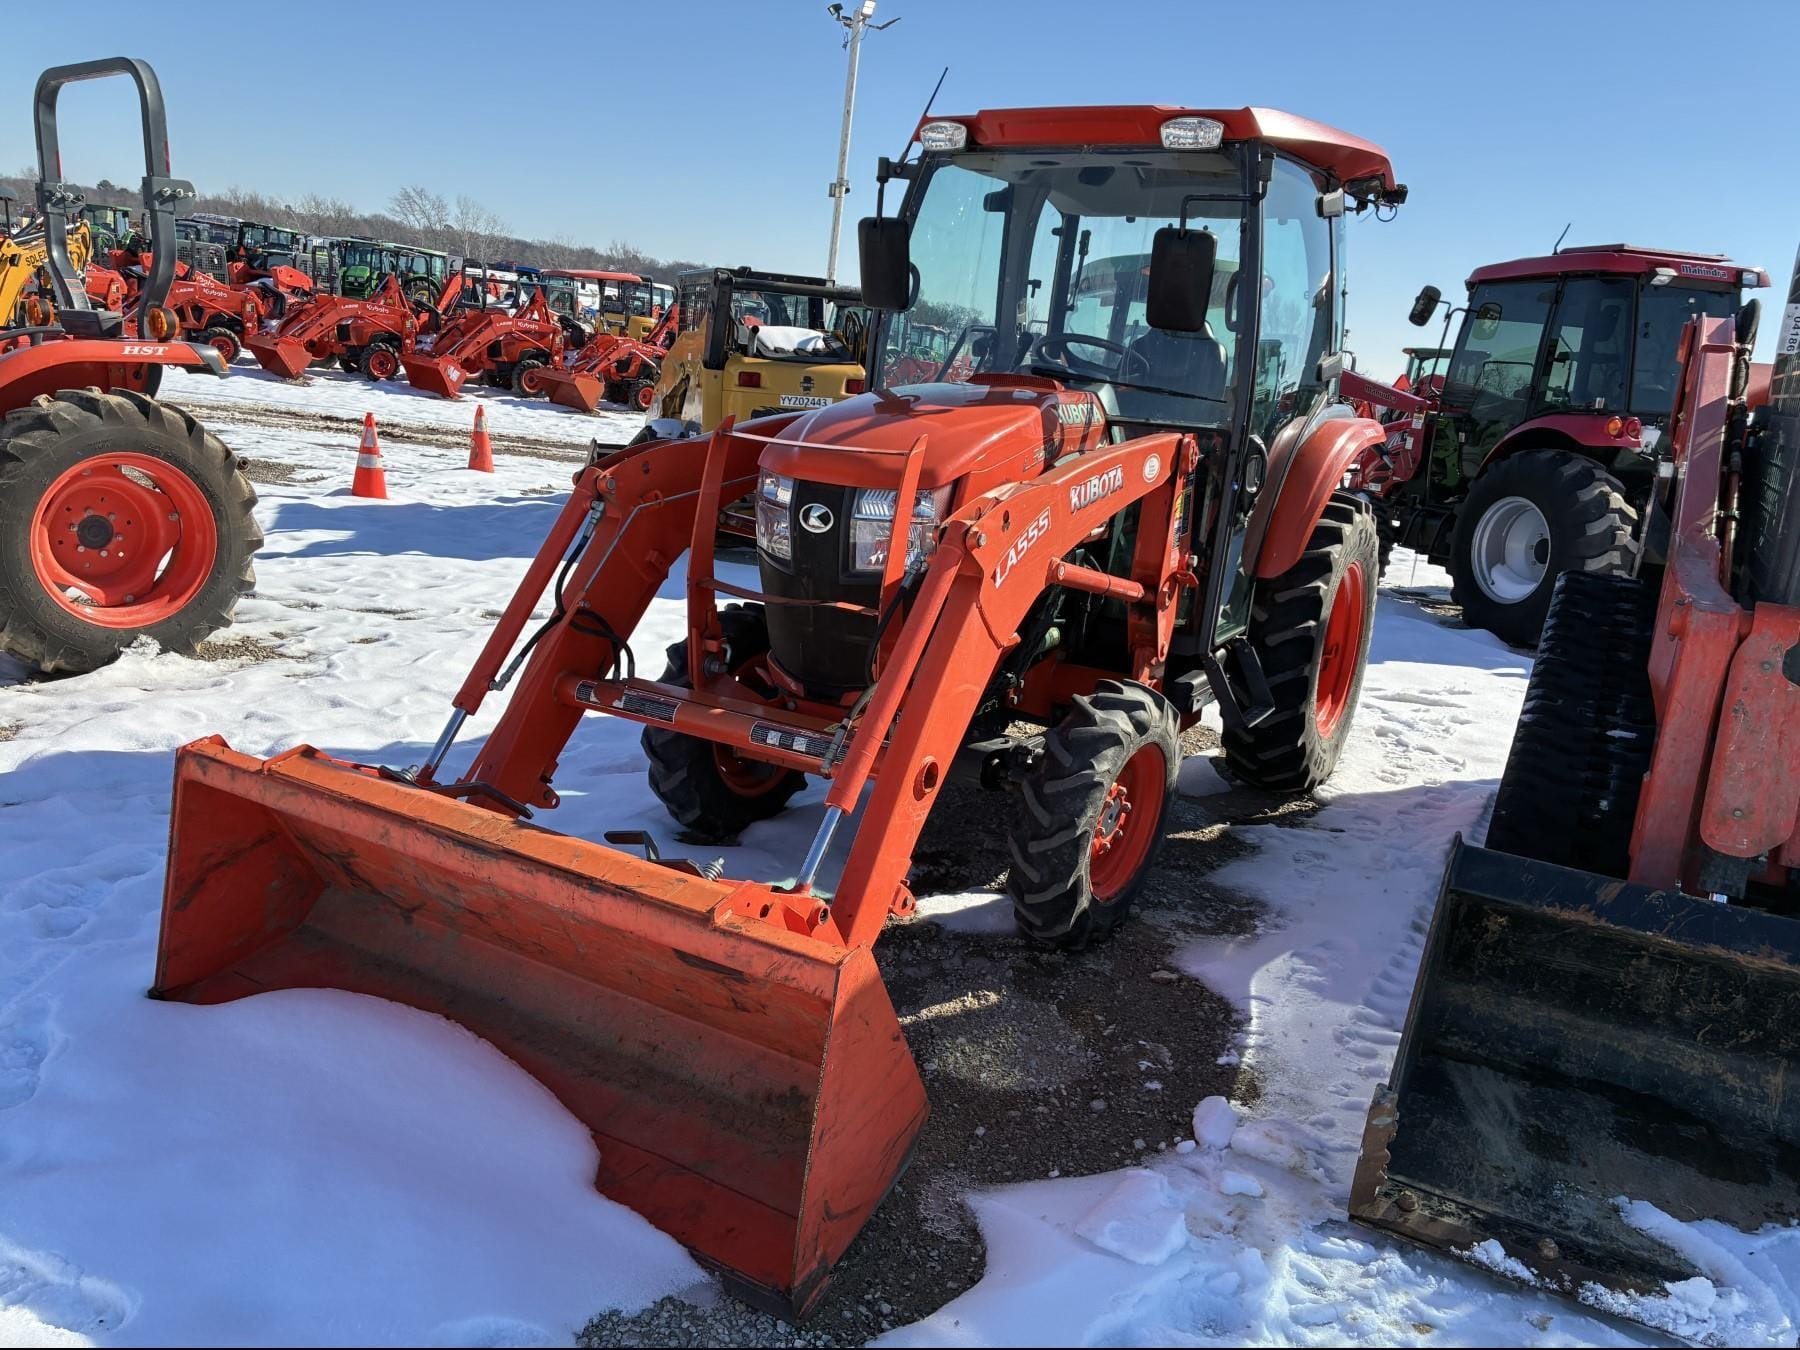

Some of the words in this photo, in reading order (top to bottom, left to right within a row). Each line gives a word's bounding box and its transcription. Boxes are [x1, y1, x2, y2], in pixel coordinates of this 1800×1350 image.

[1681, 264, 1728, 279] Mahindra
[203, 287, 228, 298] Kubota
[366, 303, 390, 314] Kubota
[121, 345, 169, 356] HST
[781, 396, 828, 407] YYZ02443
[1070, 465, 1124, 514] KUBOTA
[995, 509, 1050, 589] LA555
